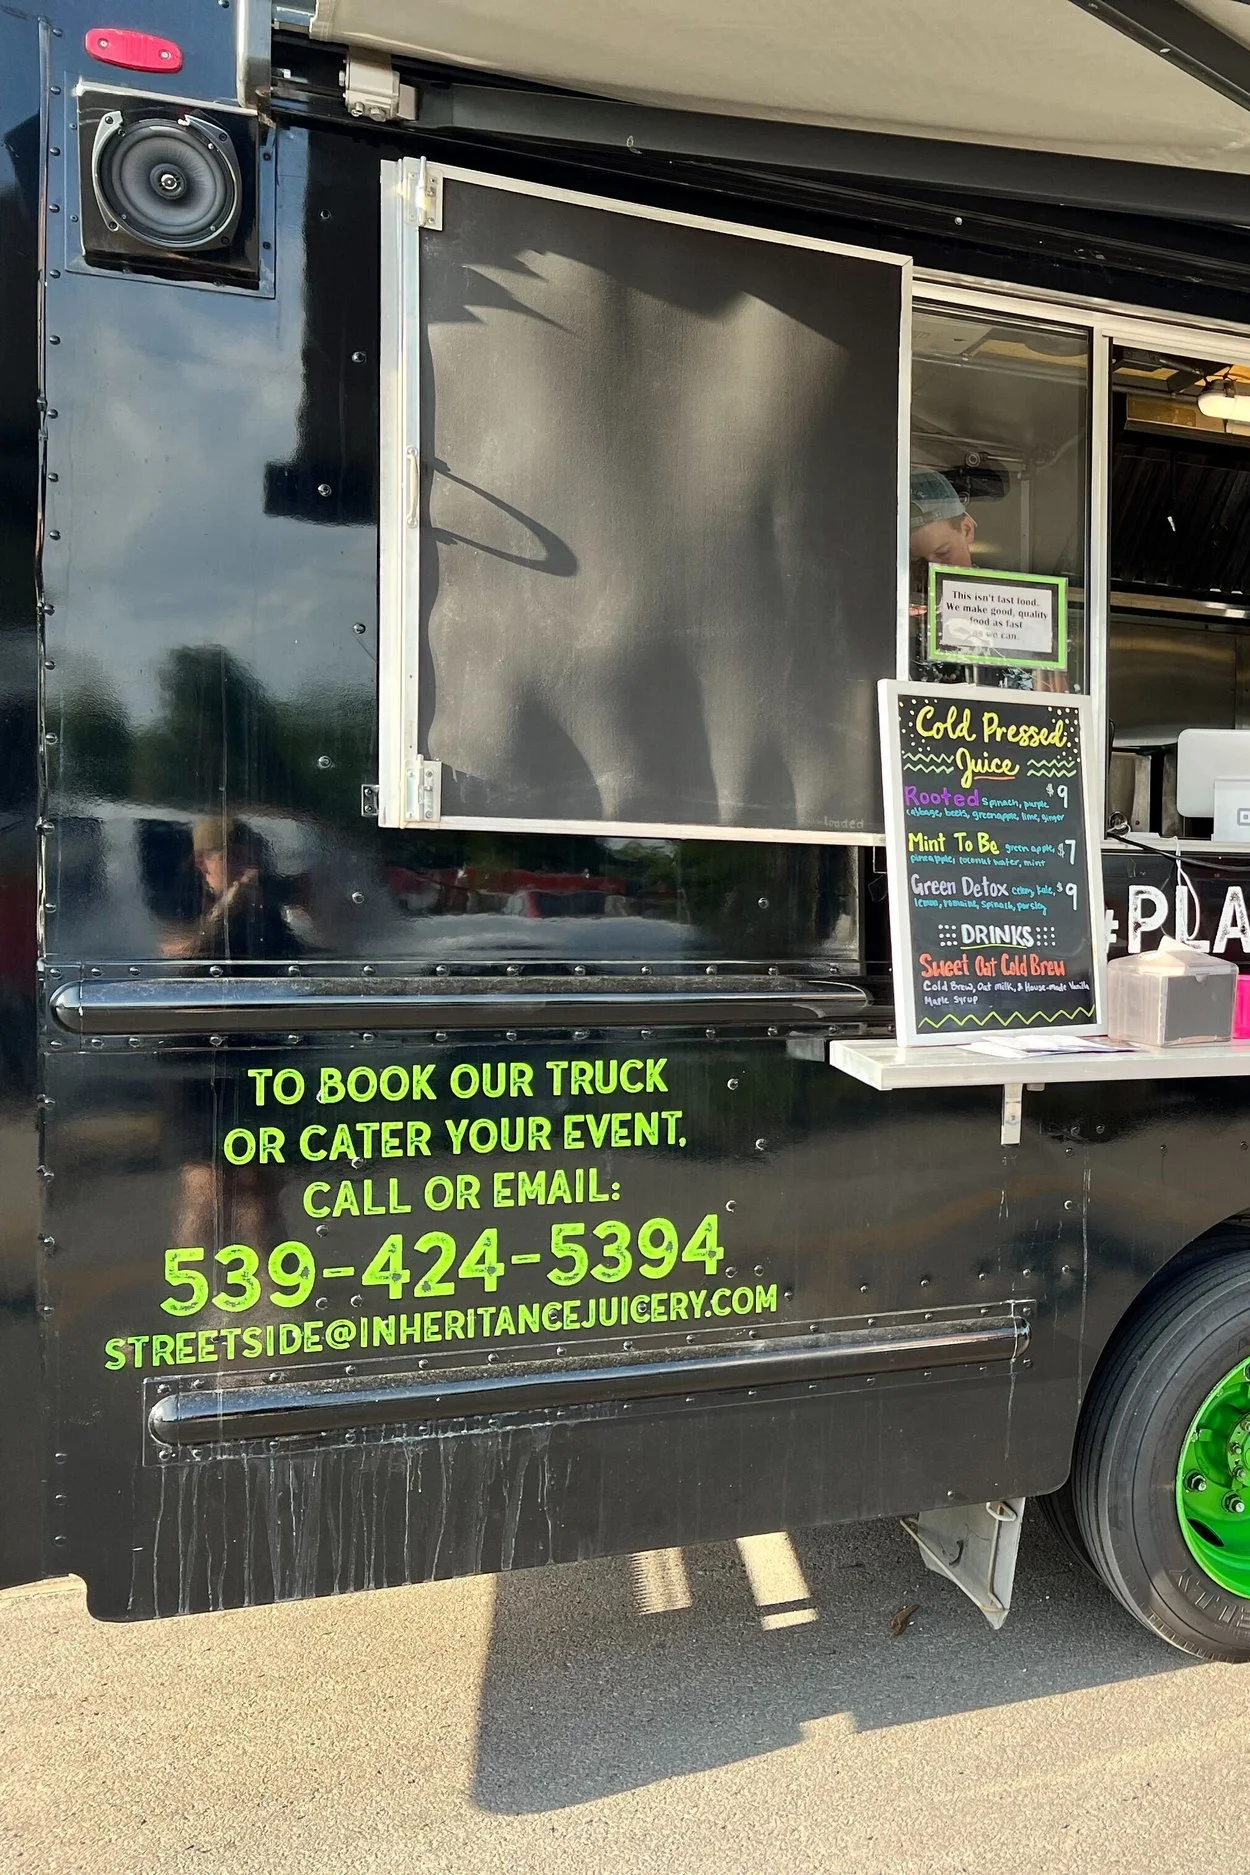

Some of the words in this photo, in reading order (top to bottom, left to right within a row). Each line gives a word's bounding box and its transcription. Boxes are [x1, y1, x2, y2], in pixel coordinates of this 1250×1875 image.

[952, 590, 972, 600] This
[974, 593, 995, 602] isn't
[946, 602, 960, 611] We
[963, 605, 988, 614] make
[990, 607, 1016, 618] good,
[916, 706, 977, 741] Cold
[982, 711, 1067, 748] Pressed
[955, 747, 1020, 788] Juice
[903, 786, 980, 807] Rooted
[907, 832, 946, 852] Mint
[953, 832, 974, 853] To
[976, 832, 1000, 855] Be
[1023, 859, 1046, 867] mint
[910, 873, 957, 896] Green
[961, 876, 1009, 897] Detox
[960, 923, 1035, 948] DRINKS
[919, 953, 970, 978] Sweet
[974, 955, 998, 977] Oat
[1001, 953, 1027, 976] Cold
[1030, 954, 1066, 976] Brew
[923, 980, 948, 991] Cold
[950, 981, 977, 993] Brew,
[924, 995, 949, 1006] Maple
[247, 1067, 306, 1106] TO
[320, 1063, 437, 1104] BOOK
[450, 1062, 534, 1101] OUR
[546, 1057, 668, 1097] TRUCK
[223, 1127, 285, 1165] OR
[299, 1121, 432, 1161] CATER
[444, 1117, 552, 1156] YOUR
[302, 1178, 411, 1219] CALL
[423, 1172, 482, 1211] OR
[493, 1167, 621, 1205] EMAIL:
[159, 1213, 725, 1317] 539-424-5394
[103, 1284, 780, 1372] STREETSIDE@INHERITANCEJUICERY.COM
